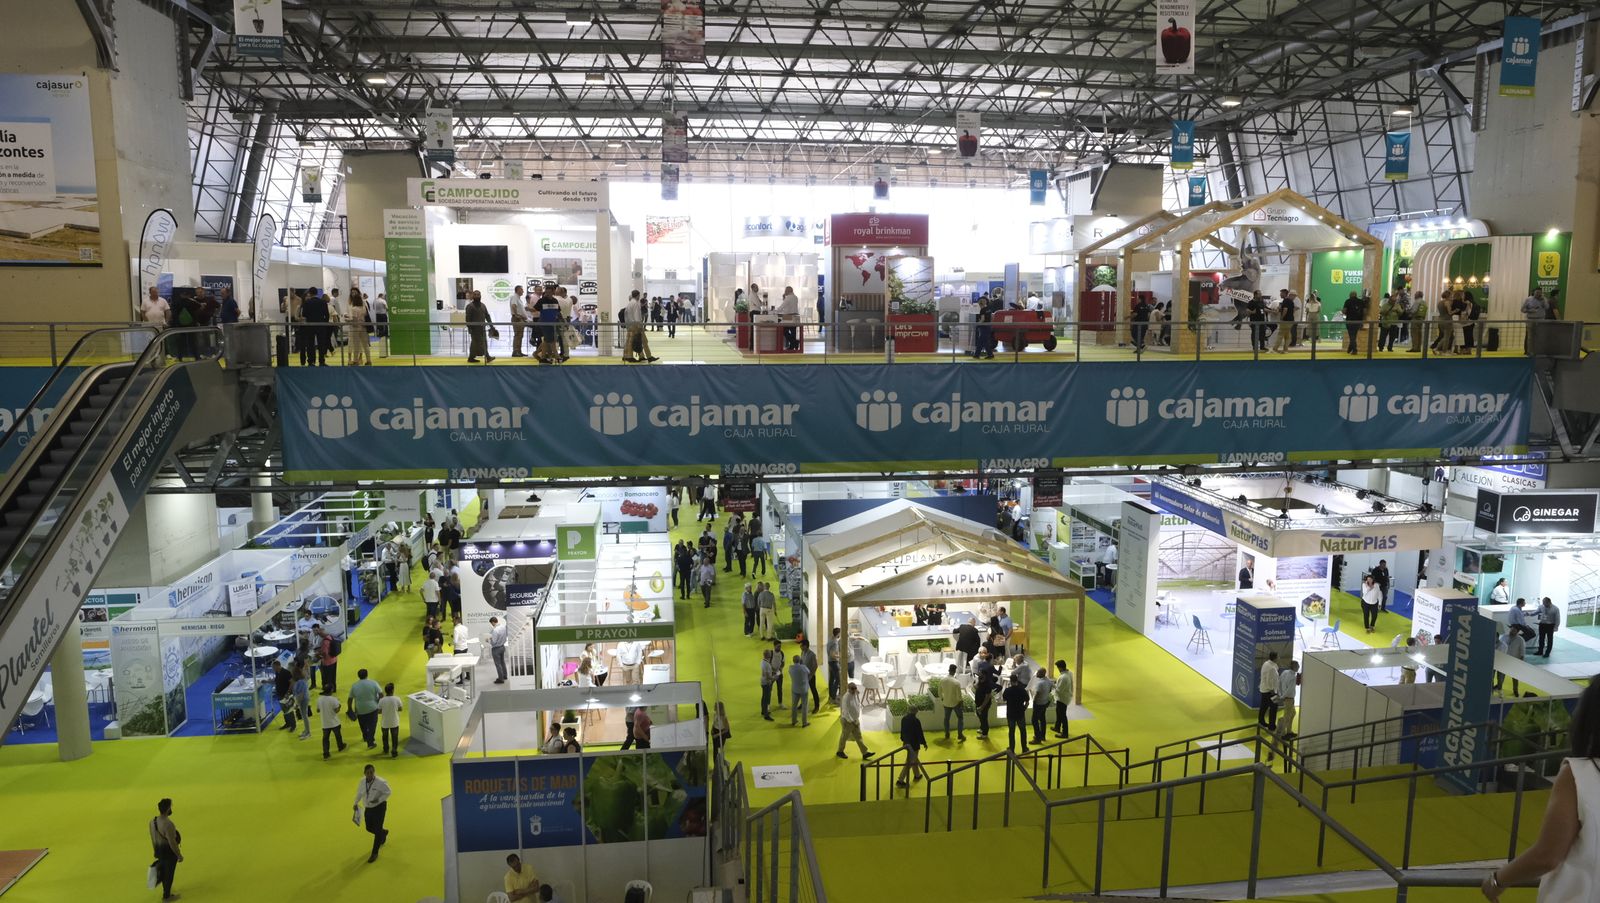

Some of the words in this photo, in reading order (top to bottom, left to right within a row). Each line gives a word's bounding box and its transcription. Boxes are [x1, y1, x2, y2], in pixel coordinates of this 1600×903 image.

[1505, 56, 1533, 65] cajamar
[36, 79, 74, 91] cajasur
[438, 187, 520, 199] CAMPOEJIDO
[1267, 207, 1287, 216] Grupo
[1267, 213, 1300, 223] Tecniagro
[854, 226, 874, 235] royal
[875, 226, 911, 235] brinkman
[142, 216, 171, 276] hpnow
[255, 221, 273, 280] hpnow
[1158, 389, 1291, 428] cajamar
[1387, 386, 1510, 423] cajamar
[649, 395, 800, 436] cajamar
[912, 392, 1054, 432] cajamar
[370, 397, 530, 440] cajamar
[1223, 419, 1250, 429] CAJA
[1253, 418, 1286, 428] RURAL
[1446, 415, 1471, 425] CAJA
[122, 457, 133, 471] El
[132, 424, 153, 457] mejor
[151, 389, 174, 426] injerto
[724, 428, 754, 438] CAJA
[758, 427, 797, 438] RURAL
[982, 424, 1011, 434] CAJA
[1014, 423, 1051, 433] RURAL
[450, 431, 481, 442] CAJA
[486, 431, 527, 441] RURAL
[129, 458, 147, 488] para
[145, 445, 155, 457] tu
[154, 400, 180, 443] cosecha
[1229, 451, 1285, 463] ADNAGRO
[1450, 446, 1501, 457] ADNAGRO
[732, 463, 797, 475] ADNAGRO
[988, 457, 1049, 469] ADNAGRO
[460, 466, 529, 478] ADNAGRO
[1502, 475, 1537, 488] CLASICAS
[624, 490, 659, 498] Romancero
[1184, 503, 1195, 514] Solar
[1533, 508, 1580, 517] GINEGAR
[1231, 524, 1268, 551] NaturPláS
[1320, 535, 1397, 552] NaturPláS
[927, 572, 1005, 586] SALIPLANT
[587, 628, 638, 639] PRAYON
[31, 623, 60, 671] Semilleros
[1443, 614, 1473, 768] AGRICULTURA
[464, 777, 528, 794] ROQUETAS
[531, 776, 546, 791] DE
[550, 774, 577, 790] MAR
[500, 793, 545, 804] vanguardia
